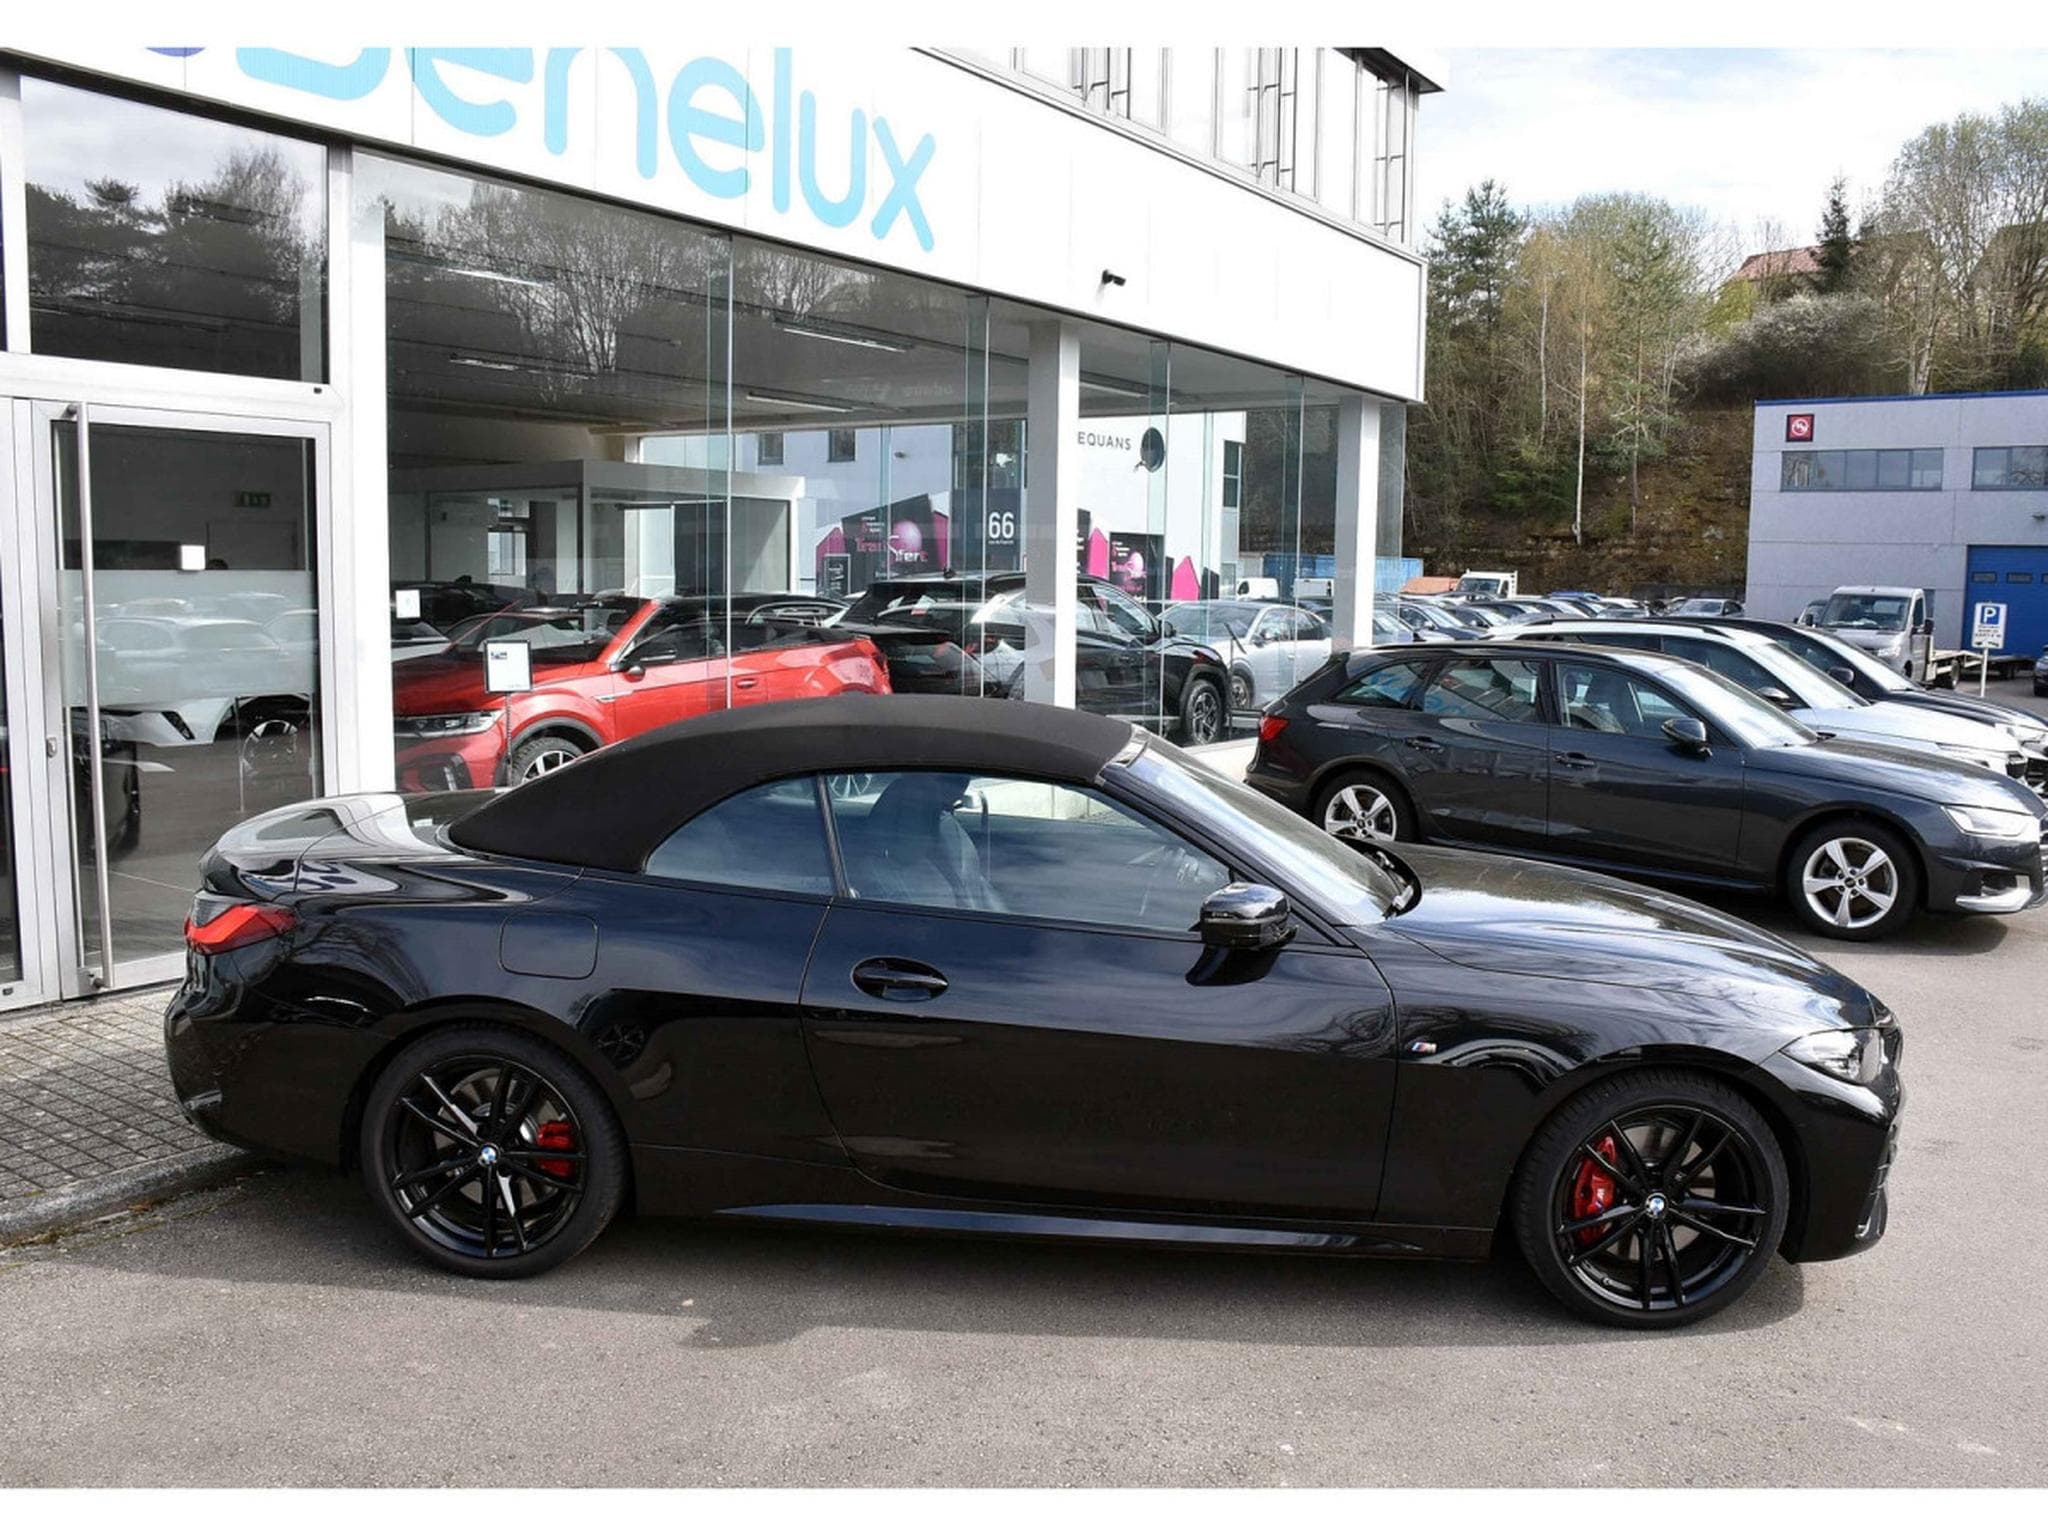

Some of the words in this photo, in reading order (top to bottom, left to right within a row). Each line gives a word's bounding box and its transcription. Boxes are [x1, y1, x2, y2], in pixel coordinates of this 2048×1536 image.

[237, 48, 936, 252] enelux
[1078, 431, 1132, 451] EQUANS
[989, 511, 1014, 539] 66
[1983, 607, 1997, 623] P
